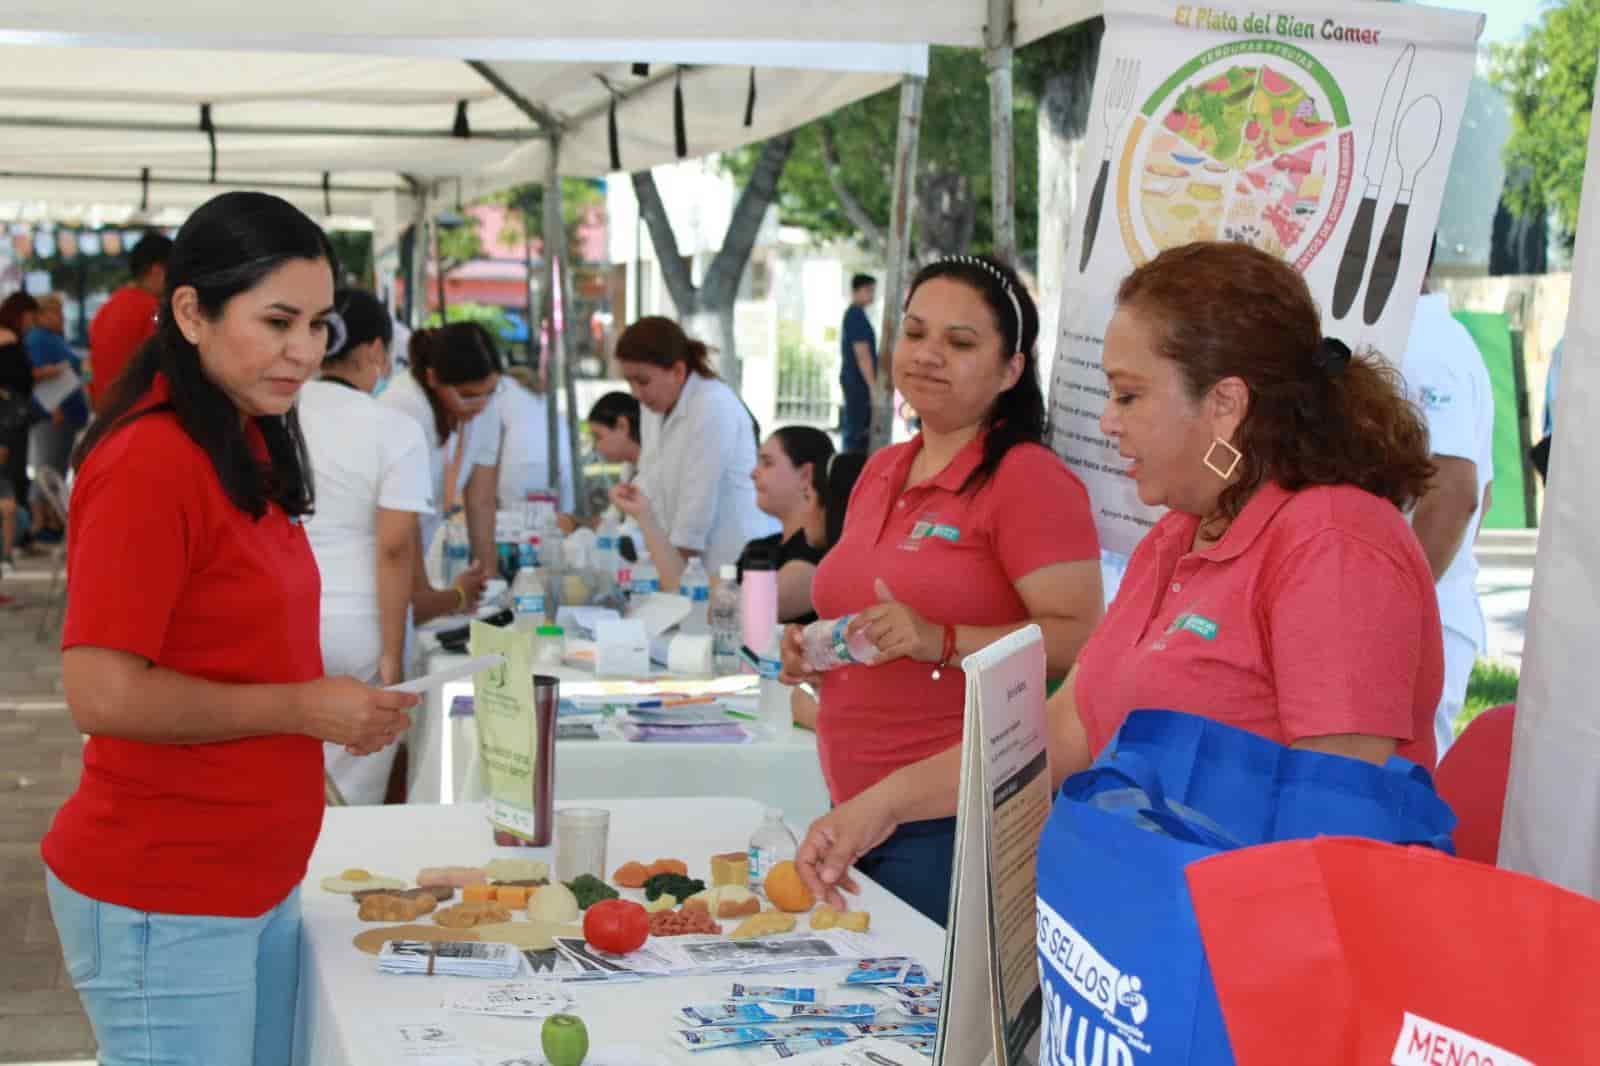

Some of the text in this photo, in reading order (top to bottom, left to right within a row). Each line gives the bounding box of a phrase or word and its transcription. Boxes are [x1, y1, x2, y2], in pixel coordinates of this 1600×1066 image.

[1175, 6, 1383, 46] El Plato del Bien Comer
[1050, 927, 1111, 1003] SELLOS
[1407, 1023, 1494, 1066] MENO
